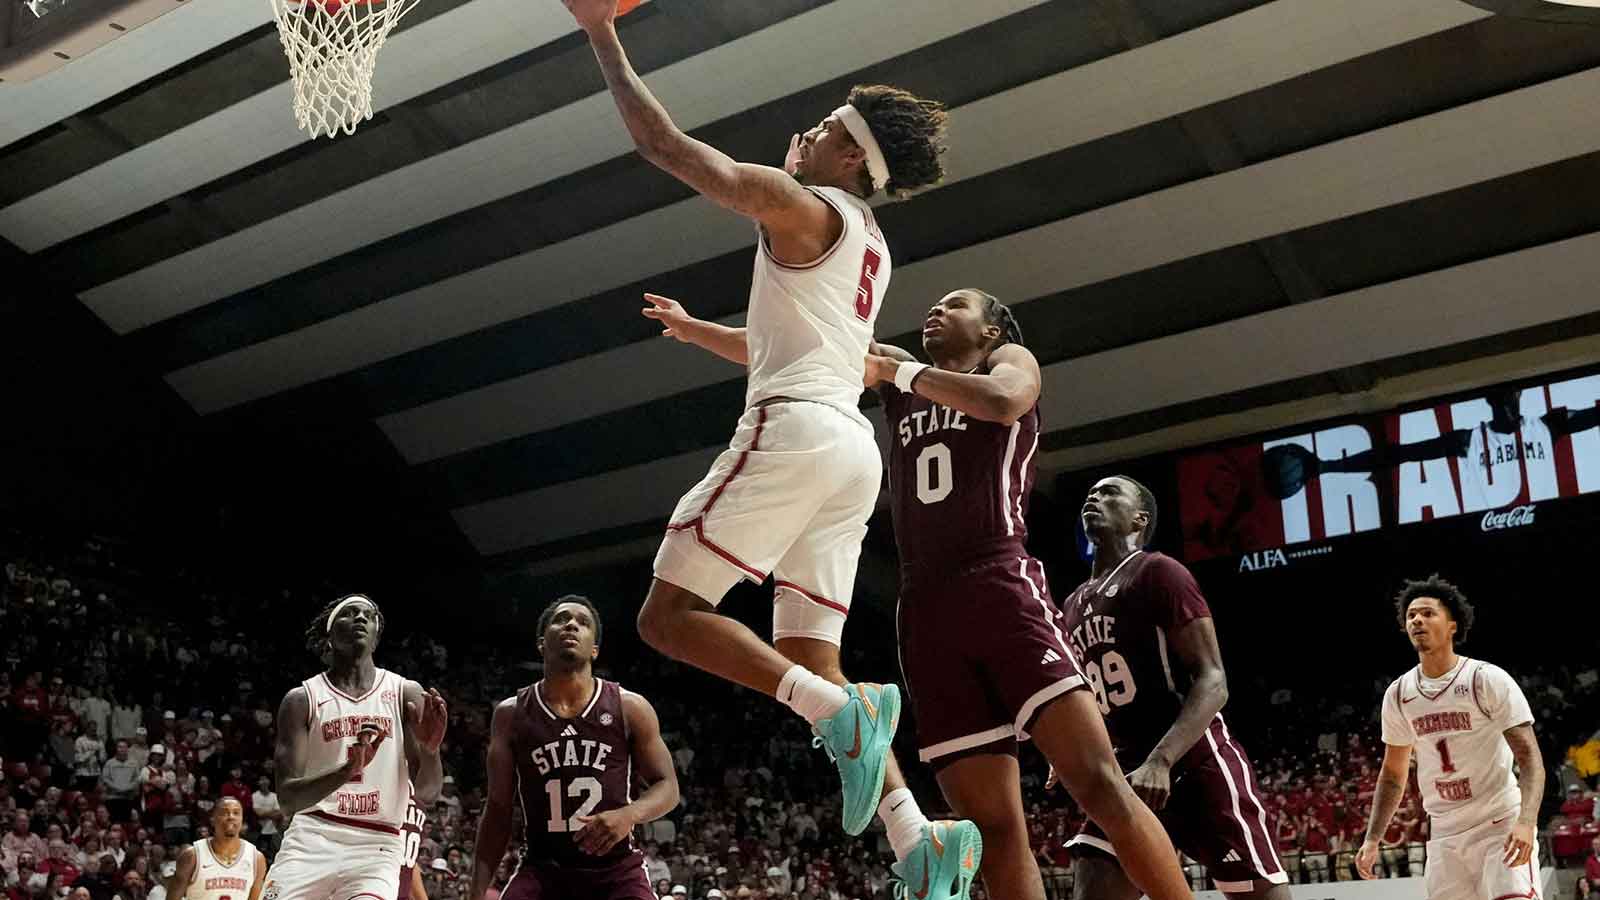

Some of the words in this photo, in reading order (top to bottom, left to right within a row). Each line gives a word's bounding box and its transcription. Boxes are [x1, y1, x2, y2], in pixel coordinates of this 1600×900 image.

[853, 244, 881, 323] 5
[899, 402, 968, 447] STATE
[916, 442, 953, 505] 0
[1479, 441, 1545, 466] ALABMA
[1239, 549, 1288, 573] ALFA
[1070, 615, 1116, 661] STATE
[1086, 650, 1137, 715] 99
[1411, 711, 1473, 737] CRIMSON
[531, 740, 613, 776] STATE
[1435, 737, 1457, 773] 1
[337, 791, 380, 816] TIDE
[545, 776, 602, 832] 12
